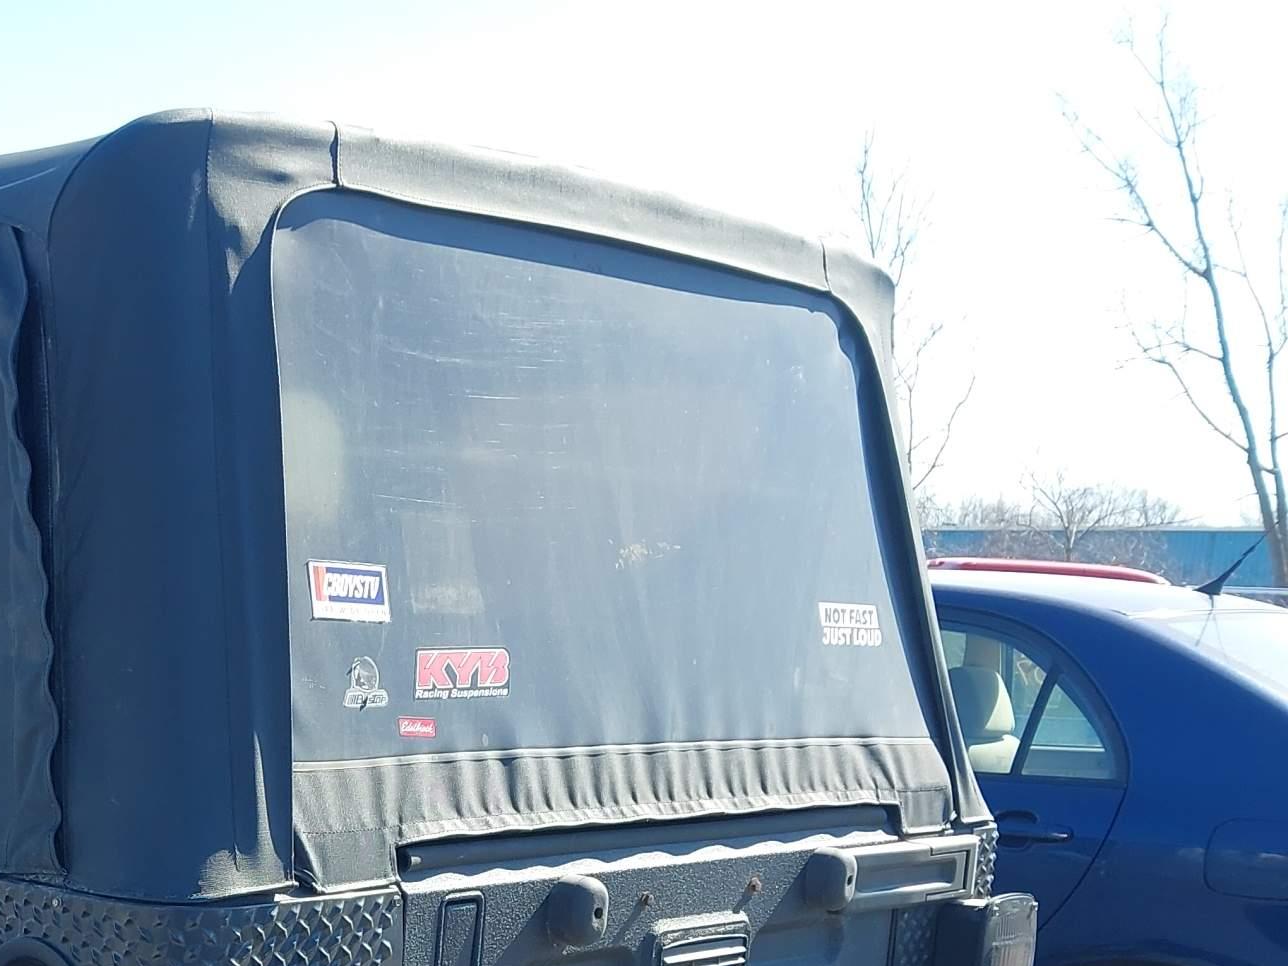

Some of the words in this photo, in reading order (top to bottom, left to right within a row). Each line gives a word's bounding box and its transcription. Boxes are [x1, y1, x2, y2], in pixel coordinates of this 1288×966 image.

[824, 608, 847, 624] NOT
[849, 608, 873, 625] FAST
[822, 627, 852, 645] JUST
[853, 628, 882, 646] LOUD
[415, 648, 509, 689] KYB
[415, 689, 449, 700] Racing
[450, 687, 509, 700] Suspensions
